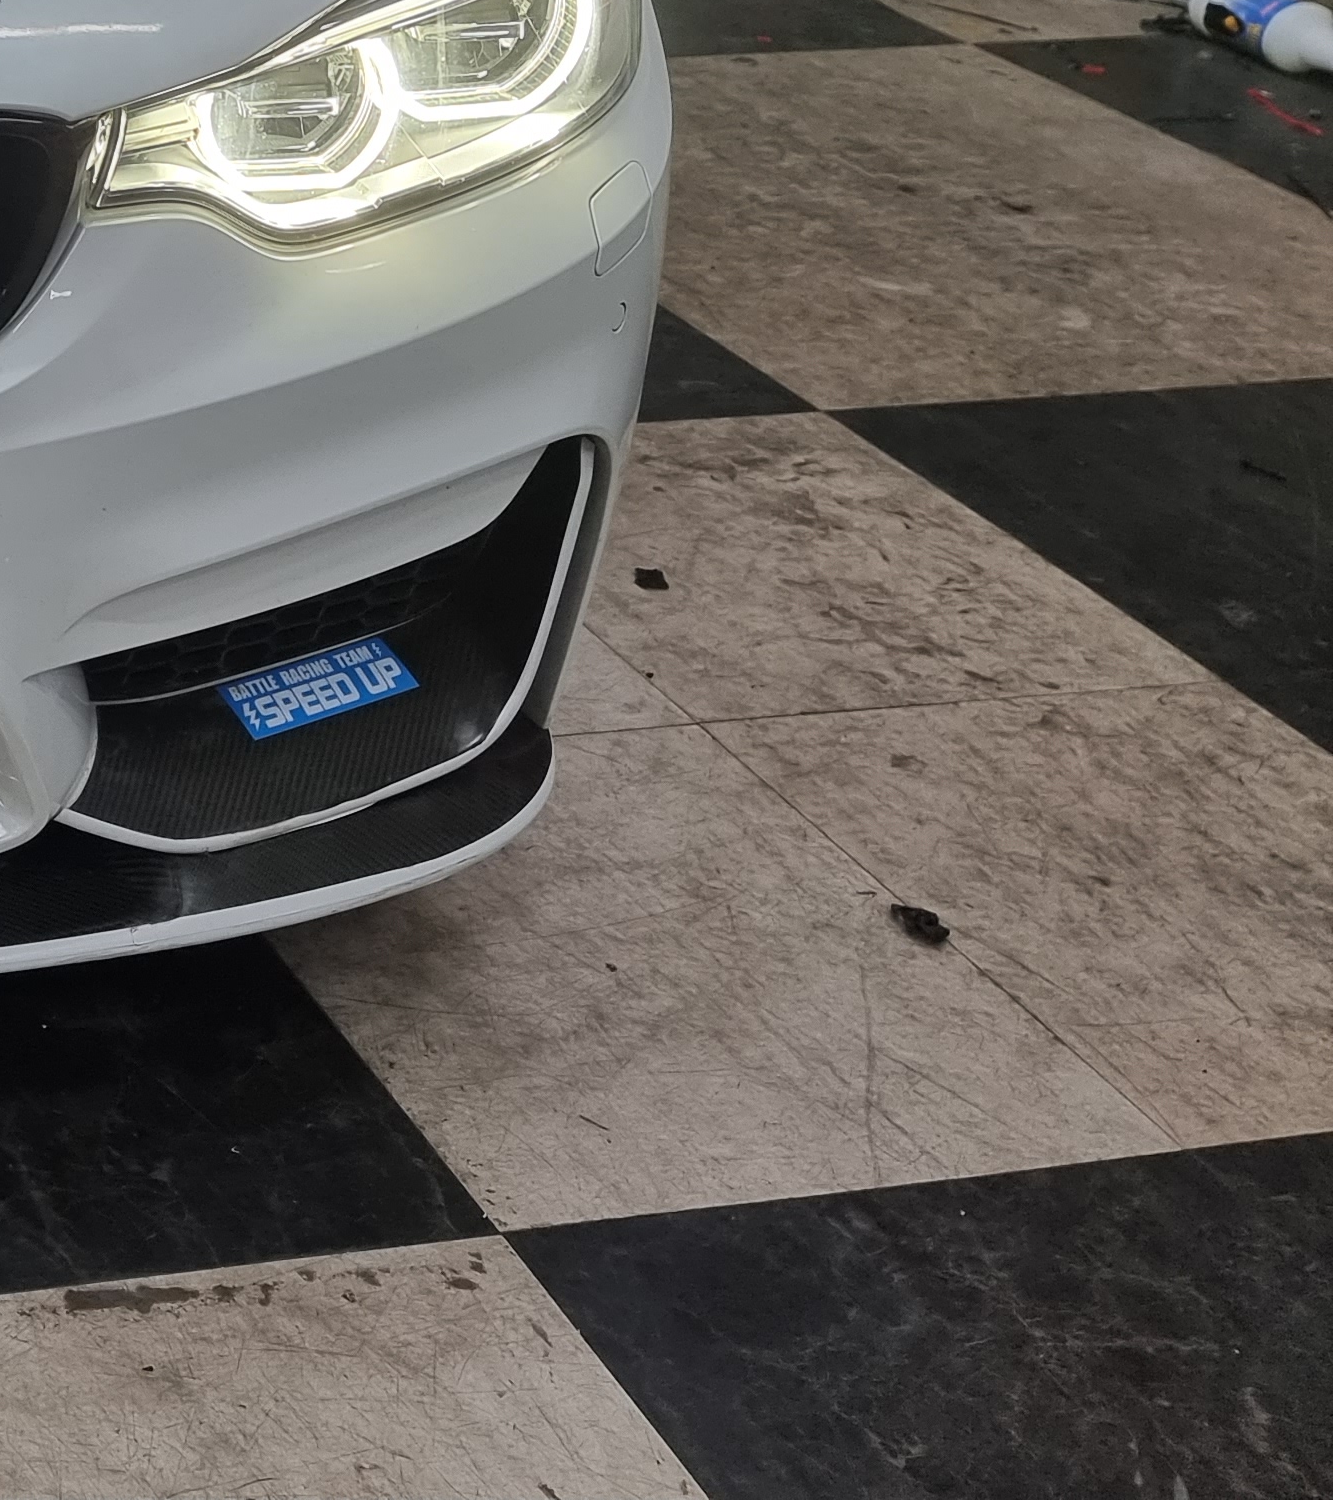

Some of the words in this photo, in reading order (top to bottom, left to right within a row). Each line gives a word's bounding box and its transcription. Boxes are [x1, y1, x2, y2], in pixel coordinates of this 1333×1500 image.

[228, 674, 281, 702] BATTLE
[279, 658, 334, 685] RACING
[333, 645, 374, 669] TEAM
[254, 671, 361, 729] SPEED
[354, 656, 402, 695] UP
